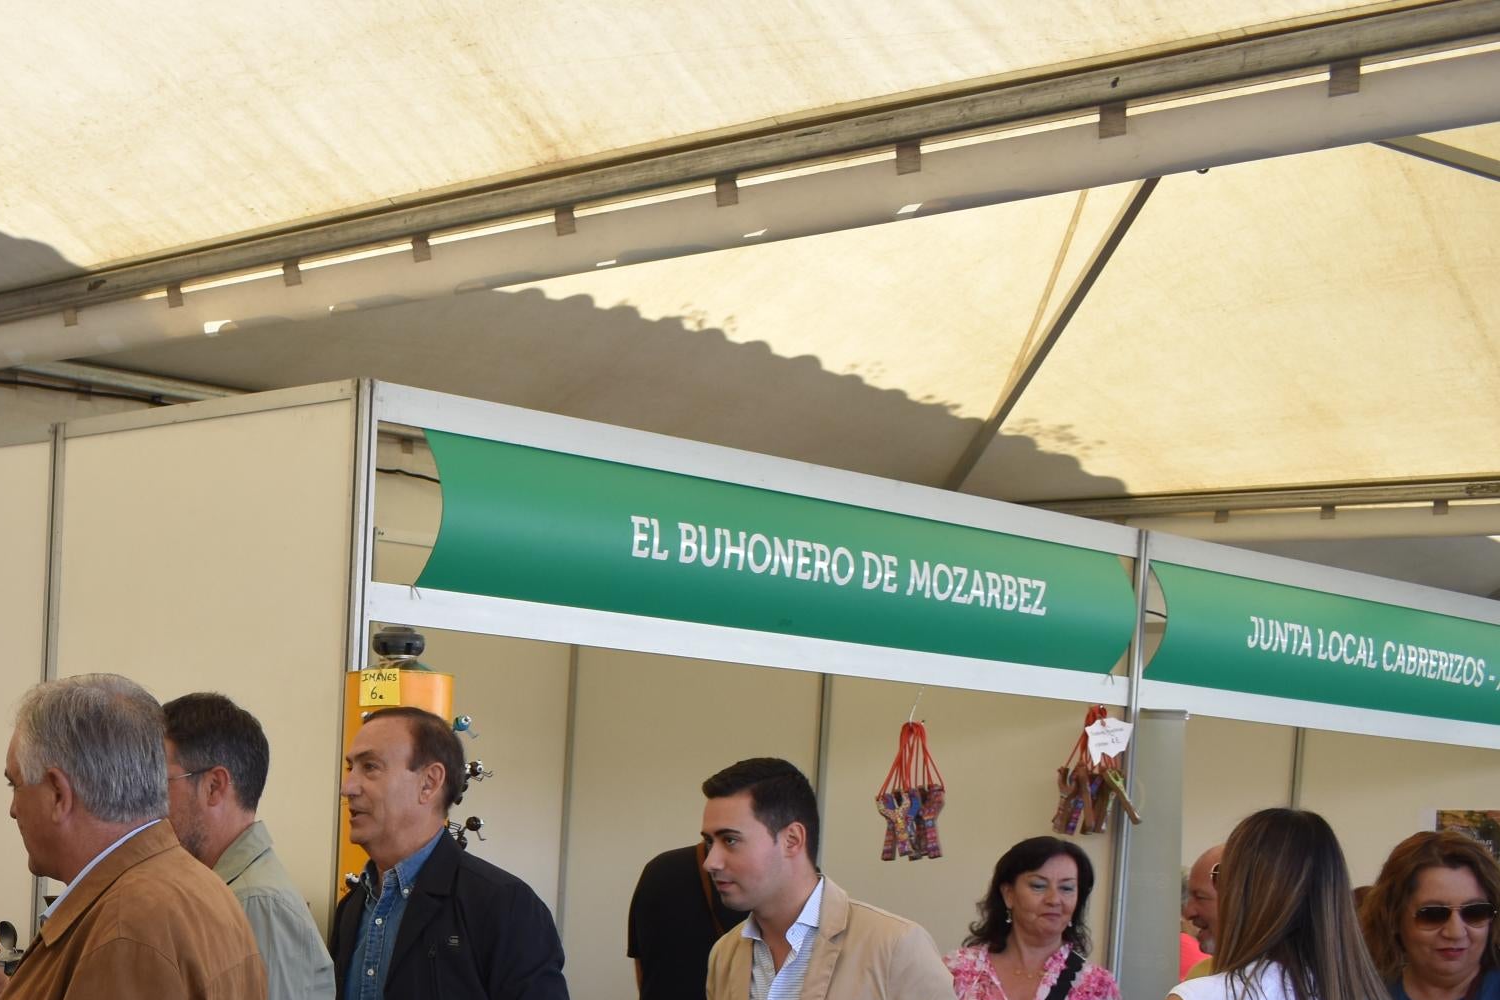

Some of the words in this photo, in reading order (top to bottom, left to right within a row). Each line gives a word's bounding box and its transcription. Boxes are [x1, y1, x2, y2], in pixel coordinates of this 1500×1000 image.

[630, 515, 669, 561] EL
[678, 522, 855, 586] BUHONERO
[861, 550, 898, 594] DE
[906, 559, 1047, 616] MOZARBEZ
[362, 672, 397, 682] IMANES
[1247, 616, 1314, 657] JUNTA
[1317, 628, 1378, 669] LOCAL
[1382, 640, 1486, 688] CABRERIZOS
